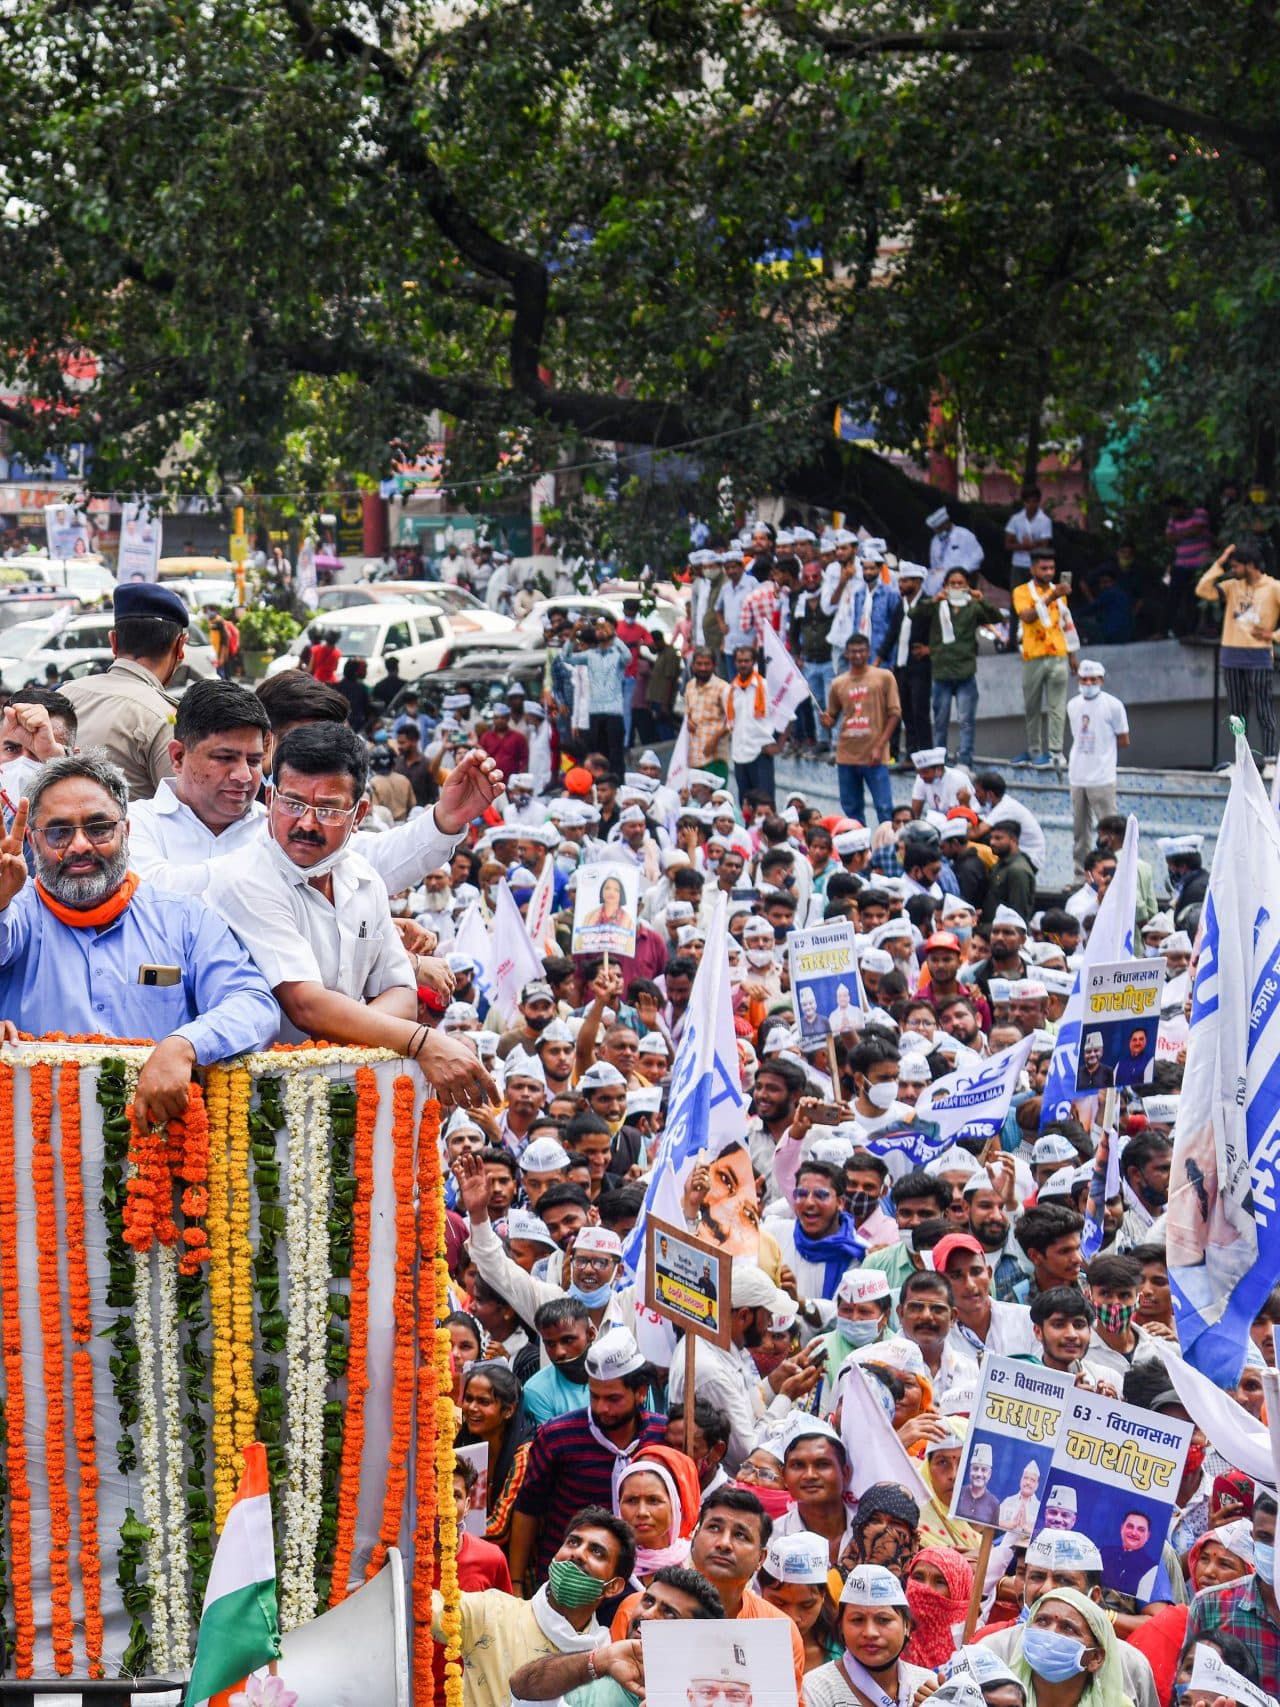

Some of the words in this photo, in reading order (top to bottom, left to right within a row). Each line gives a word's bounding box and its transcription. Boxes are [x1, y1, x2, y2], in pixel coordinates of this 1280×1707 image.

[1090, 984, 1158, 1014] काशीपुर
[1092, 976, 1104, 987] 63
[1014, 1372, 1065, 1399] विधानसभा
[986, 1392, 1061, 1442] जसपुर
[1073, 1405, 1091, 1421] 63
[1106, 1412, 1183, 1450] विधानसभा
[1066, 1429, 1176, 1491] काशीपुर
